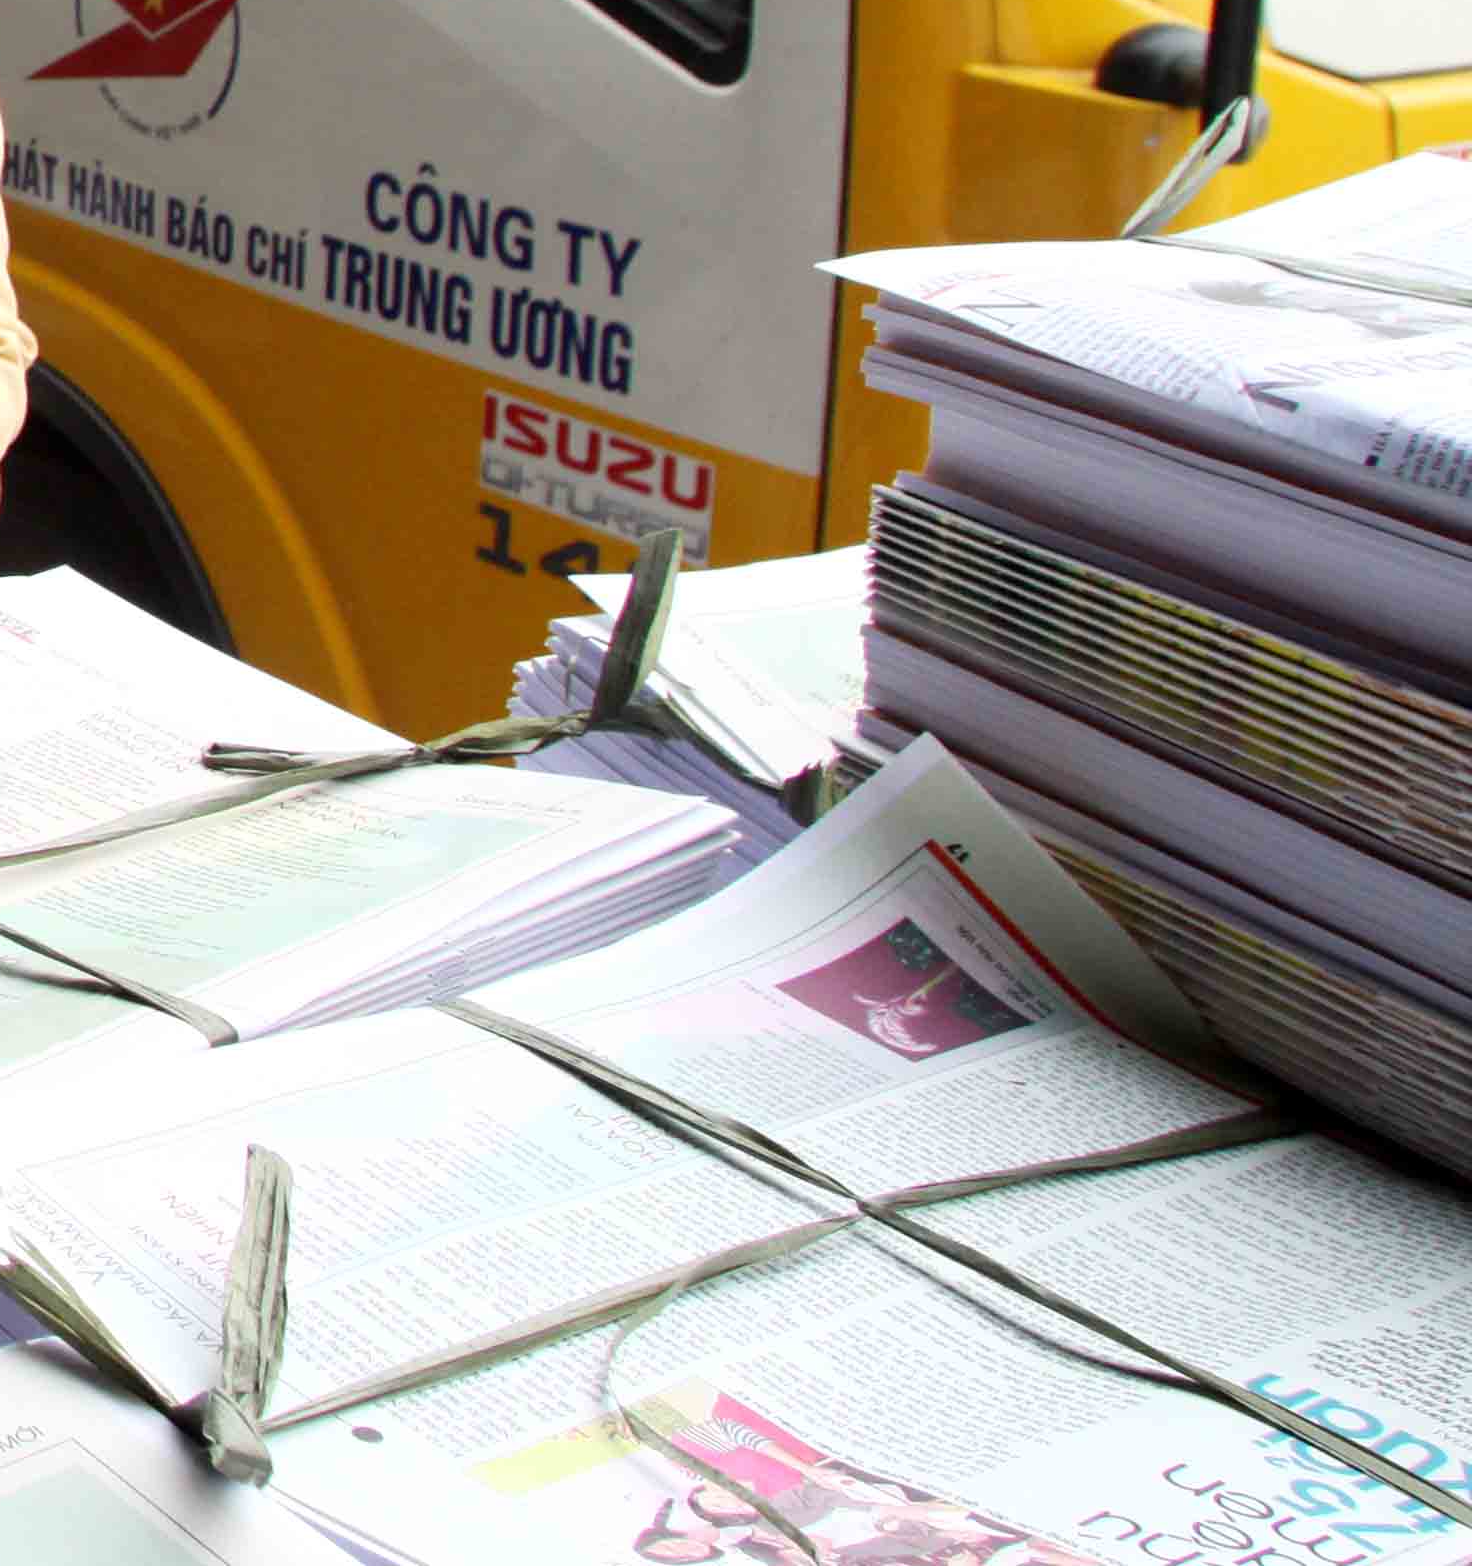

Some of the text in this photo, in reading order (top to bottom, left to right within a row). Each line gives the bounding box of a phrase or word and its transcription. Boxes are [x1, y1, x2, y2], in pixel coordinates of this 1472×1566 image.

[68, 160, 156, 239] HÀNH
[167, 194, 235, 265] BÁO
[247, 226, 310, 291] CHÍ
[321, 234, 473, 344] TRUNG
[490, 286, 634, 395] ƯƠNG
[366, 162, 642, 297] CÔNG TY
[484, 394, 711, 511] ISUZU
